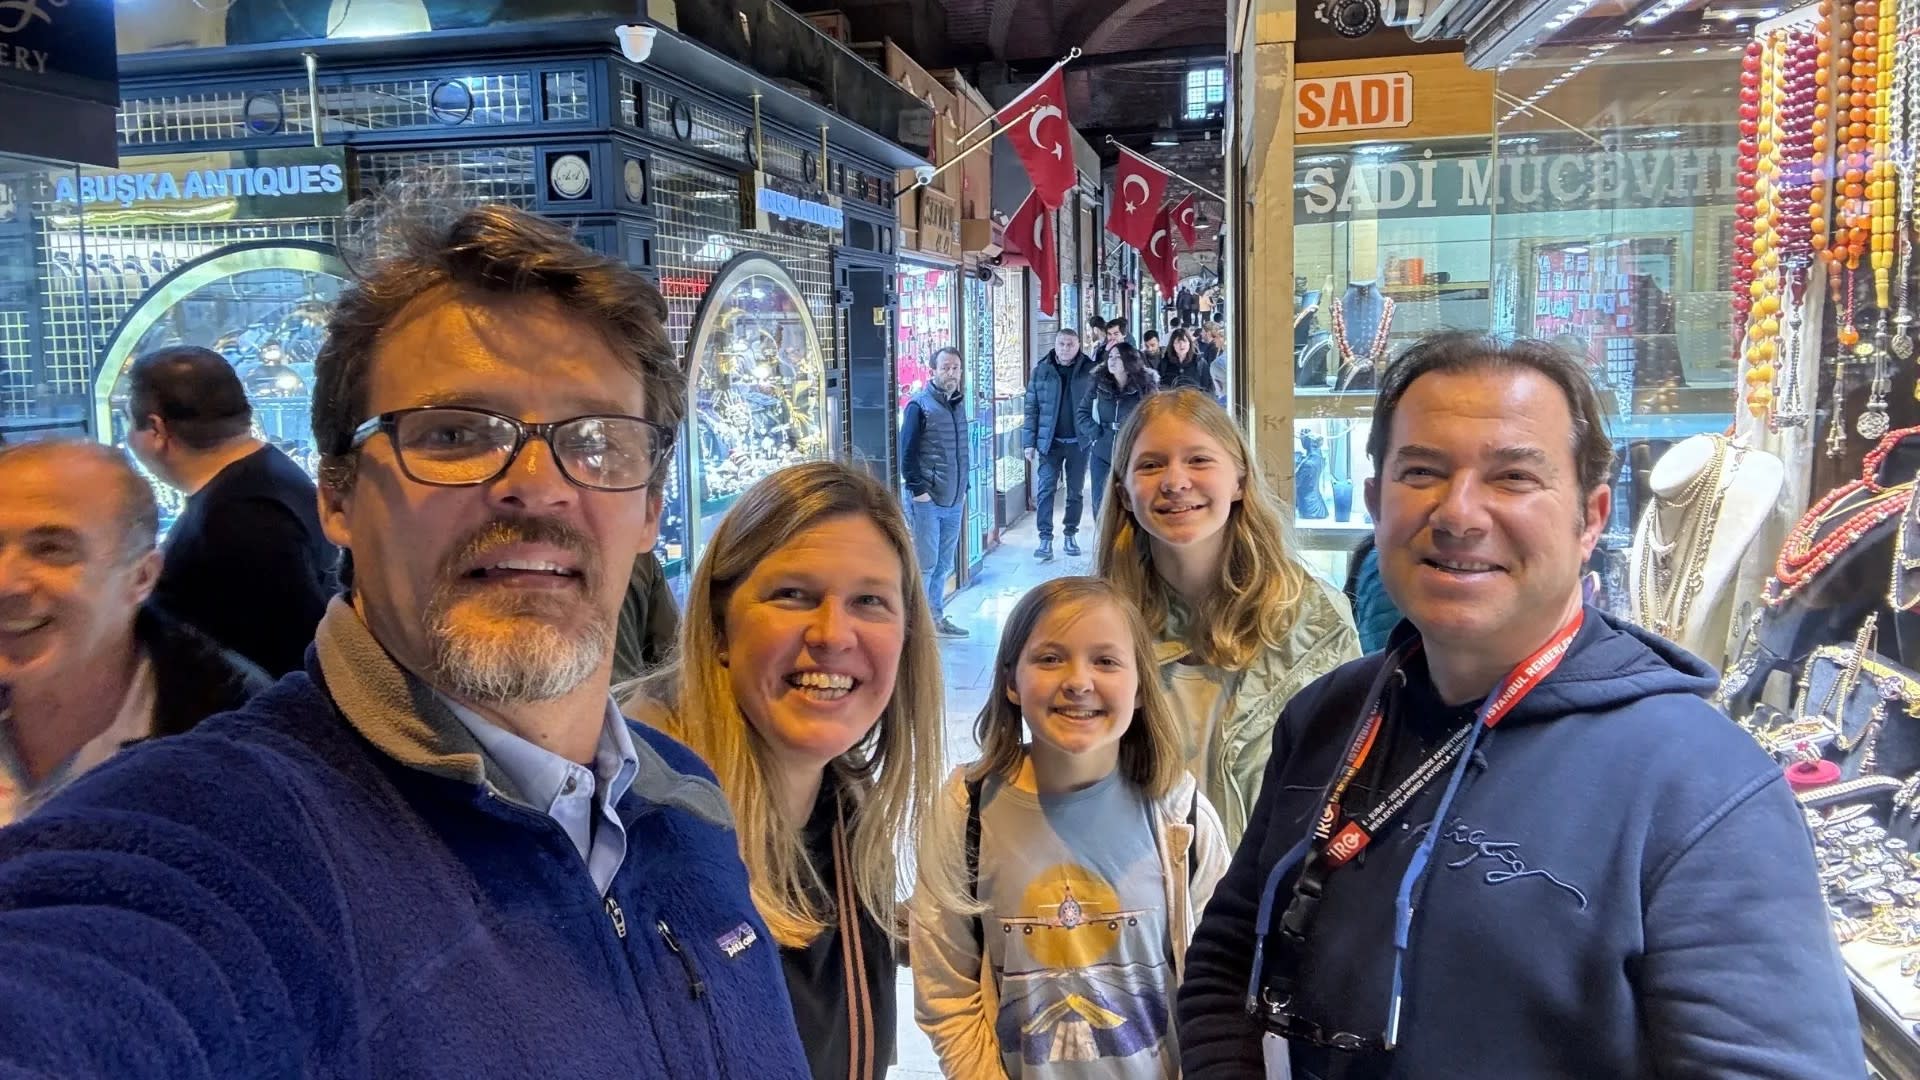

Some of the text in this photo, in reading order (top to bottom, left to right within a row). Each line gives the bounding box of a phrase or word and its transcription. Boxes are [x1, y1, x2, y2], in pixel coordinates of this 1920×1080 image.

[55, 164, 344, 208] ABUŞKA ANTIQUES
[1304, 148, 1438, 214] SADİ
